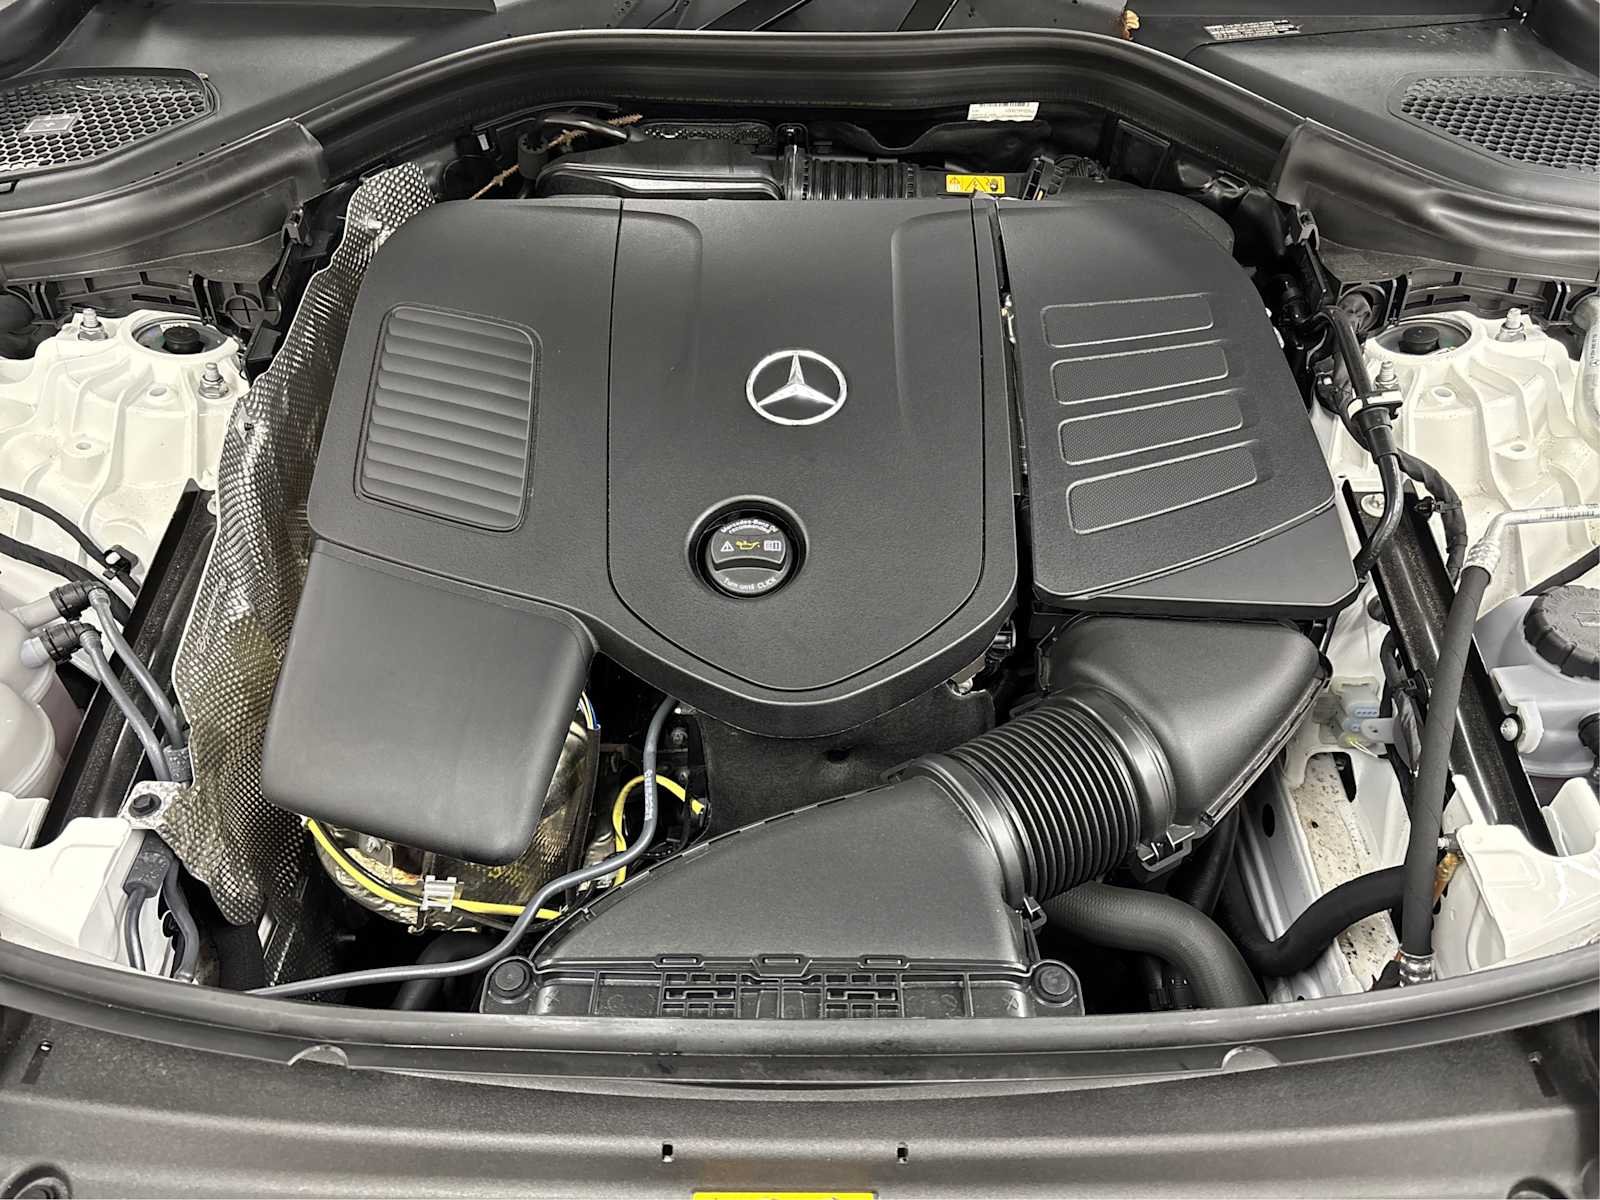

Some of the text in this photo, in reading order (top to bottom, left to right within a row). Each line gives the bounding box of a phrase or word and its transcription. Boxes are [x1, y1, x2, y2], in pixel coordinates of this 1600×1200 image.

[720, 519, 770, 533] Mercedes-Benz
[723, 577, 738, 589] Turn
[757, 577, 777, 589] CLICK
